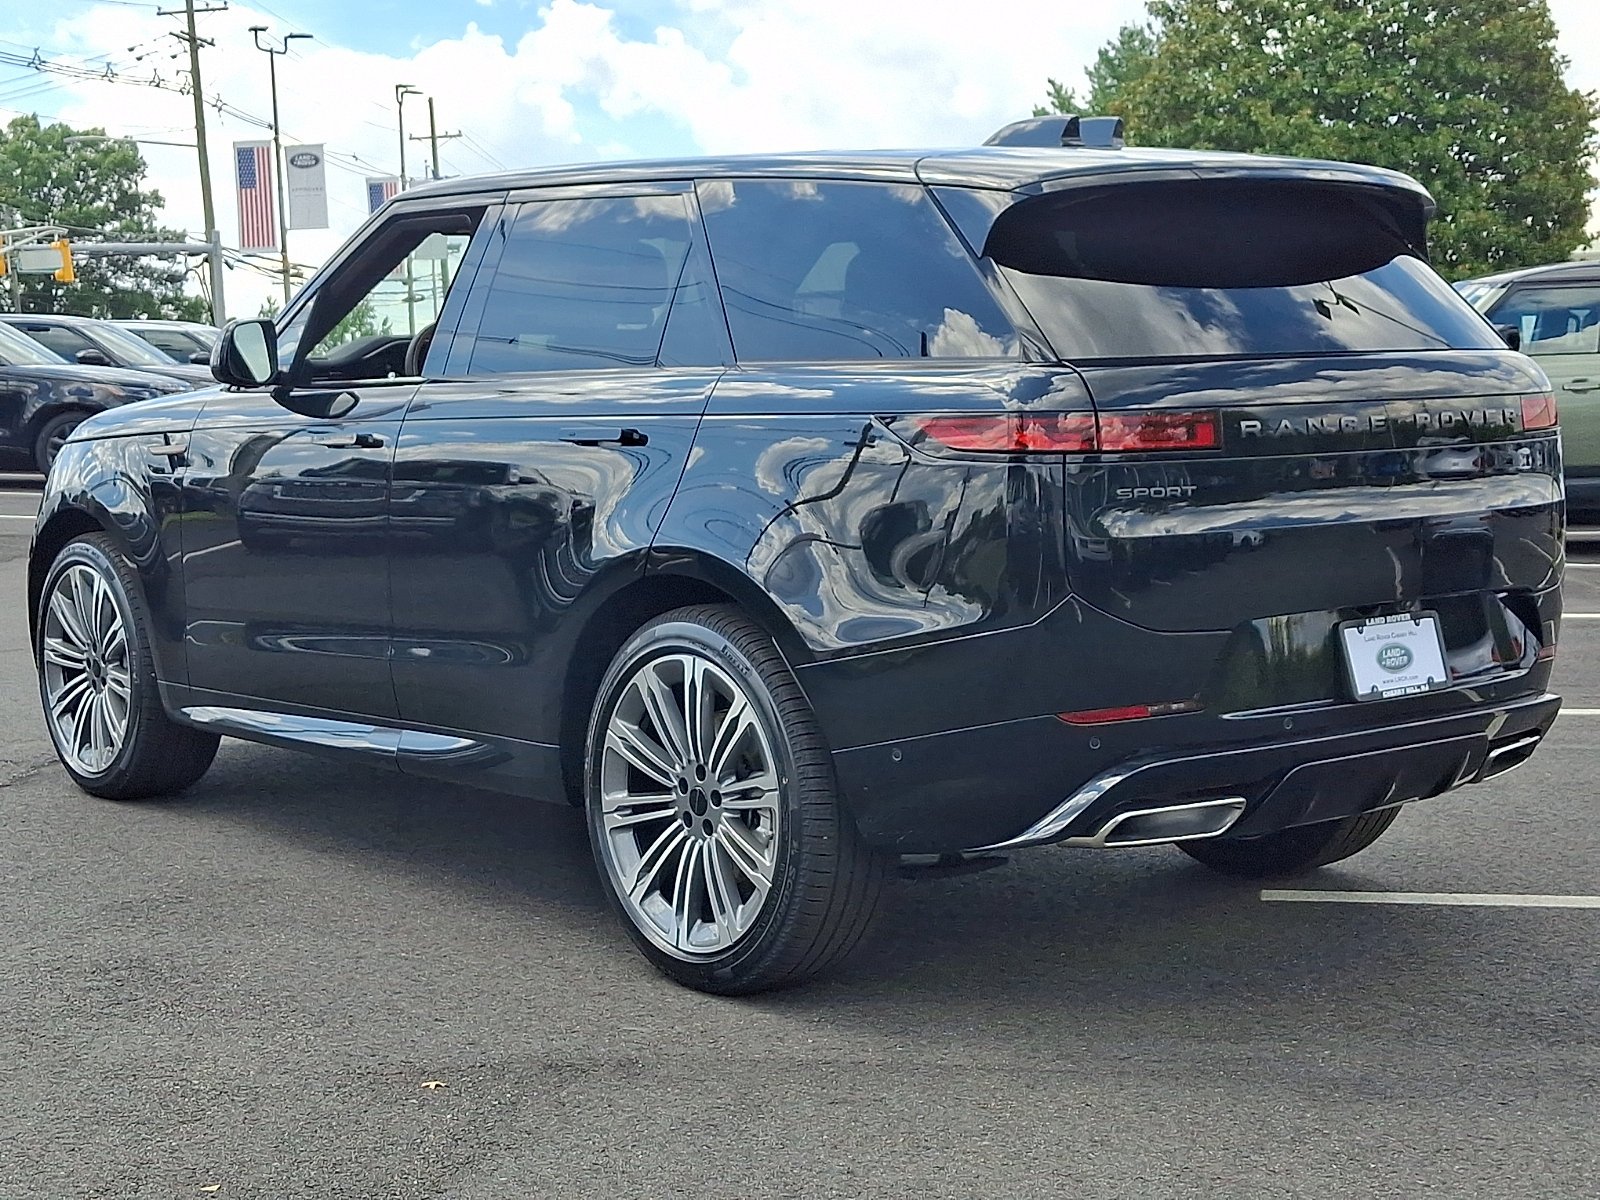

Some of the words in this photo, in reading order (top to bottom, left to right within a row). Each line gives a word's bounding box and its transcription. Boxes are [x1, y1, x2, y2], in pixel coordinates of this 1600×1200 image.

[1239, 416, 1388, 438] RANGE
[1412, 408, 1516, 429] ROVER
[1116, 485, 1197, 500] SPORT
[1365, 617, 1386, 626] LAND
[1386, 613, 1411, 623] ROVER
[1382, 648, 1401, 658] LAND
[1385, 655, 1408, 666] ROVER
[1382, 687, 1406, 698] CHERRY
